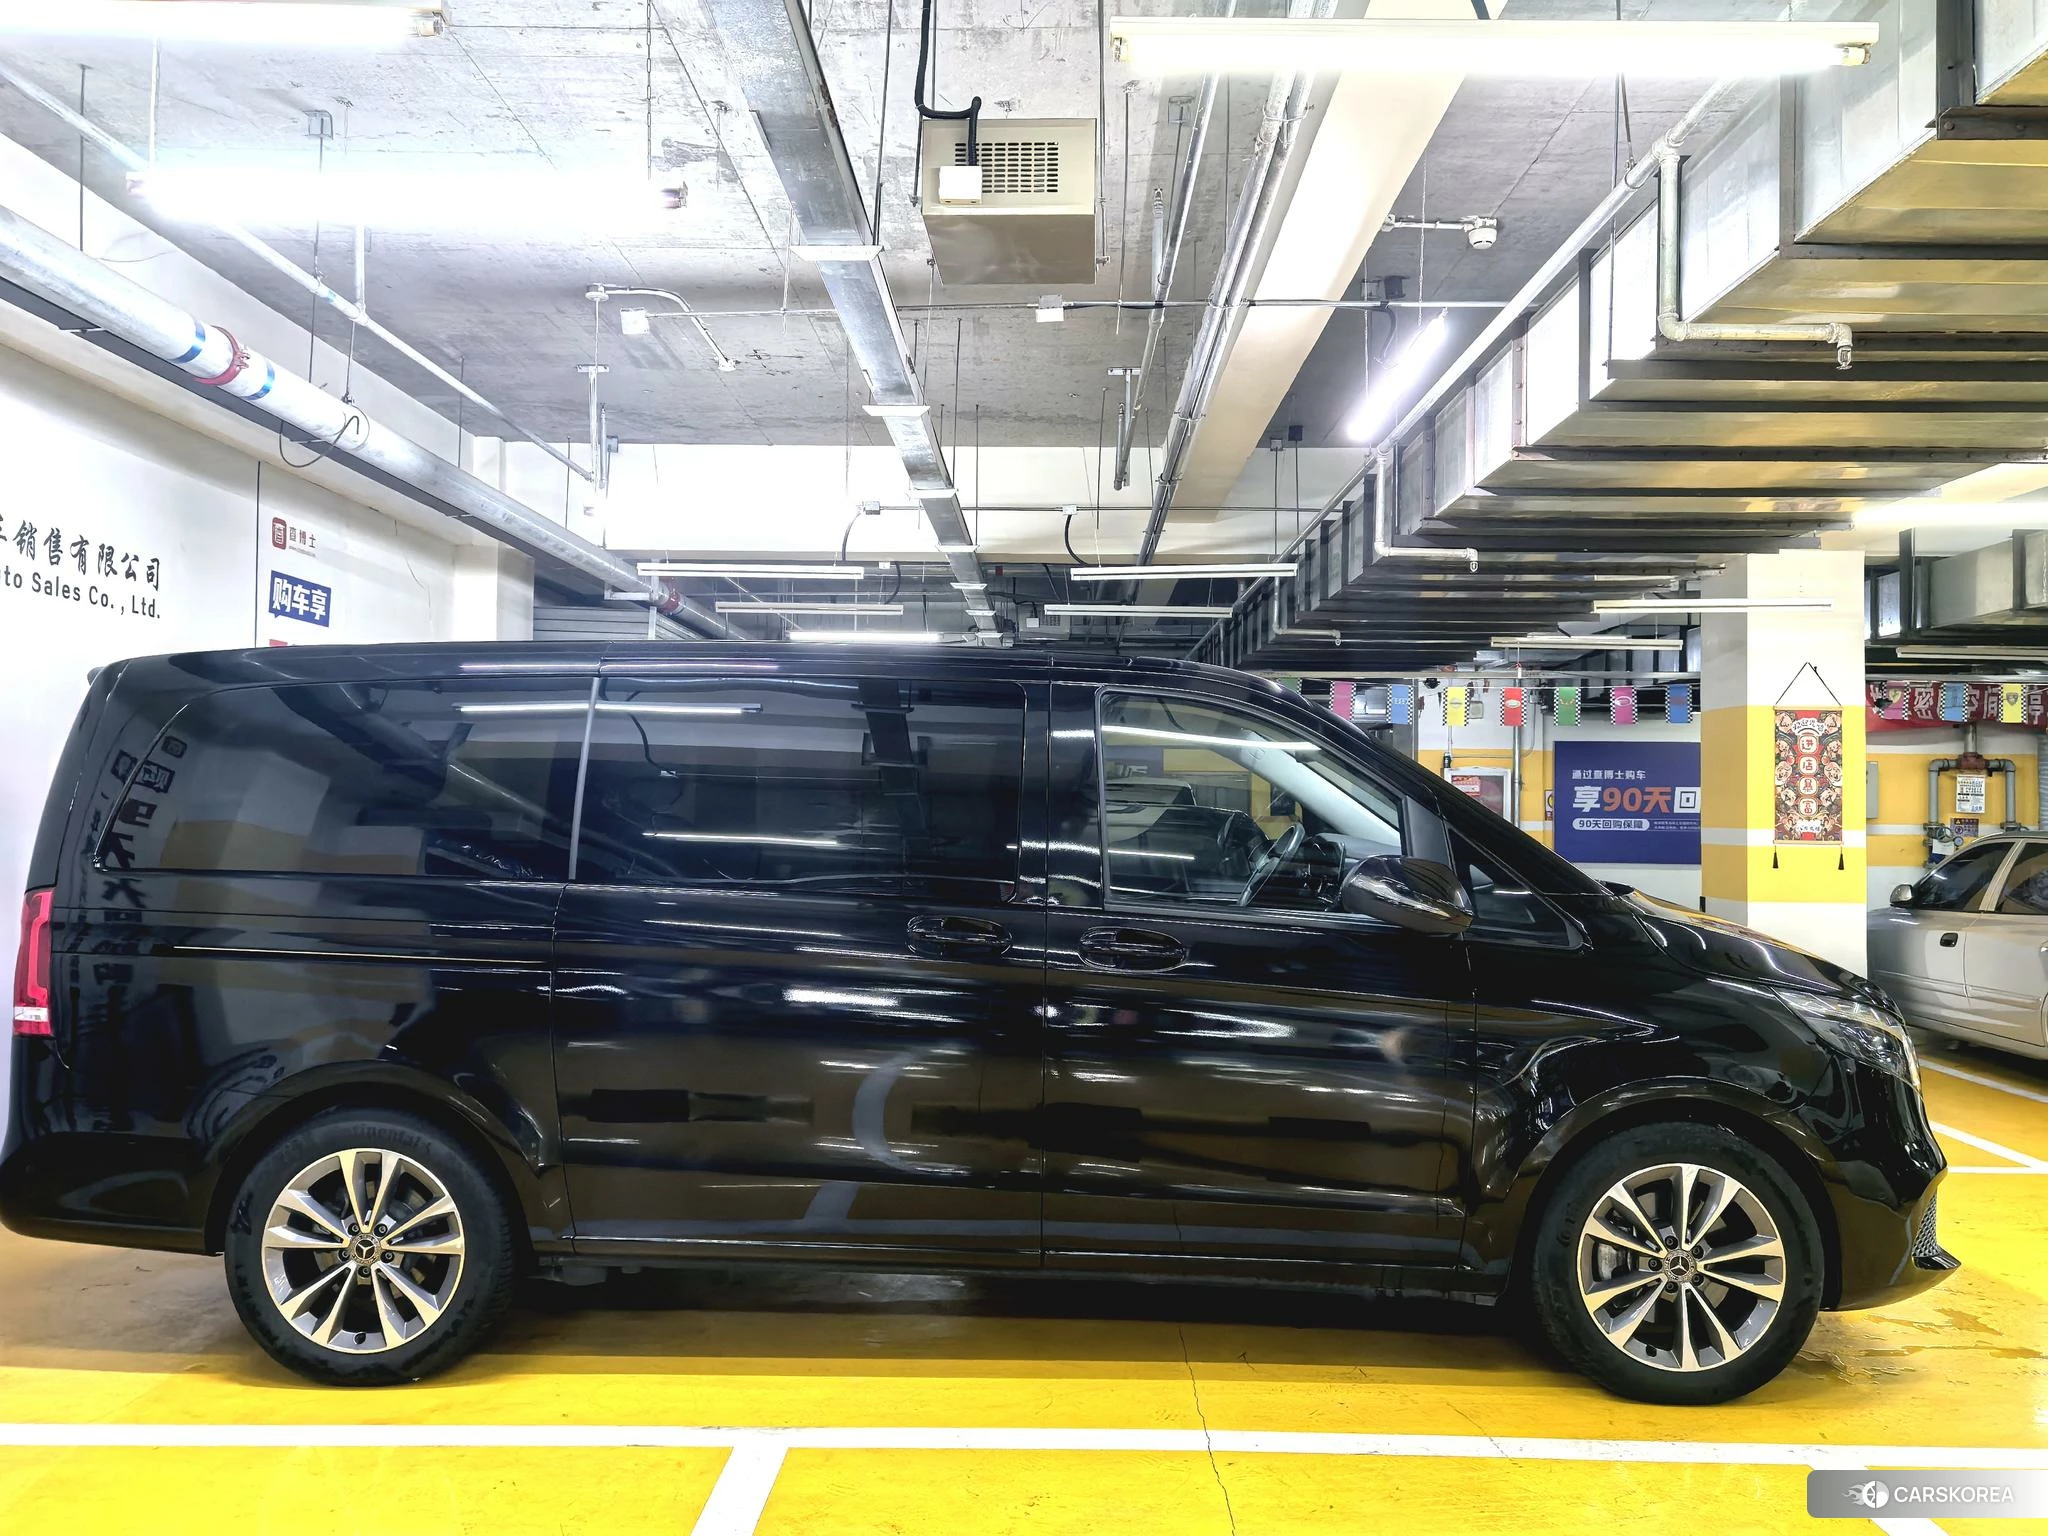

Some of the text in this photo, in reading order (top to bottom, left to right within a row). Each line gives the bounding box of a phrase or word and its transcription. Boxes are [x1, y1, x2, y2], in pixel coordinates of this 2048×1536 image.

[0, 565, 22, 589] to
[32, 571, 81, 601] Sales
[132, 594, 160, 619] Ltd.
[272, 577, 328, 621] 购车享
